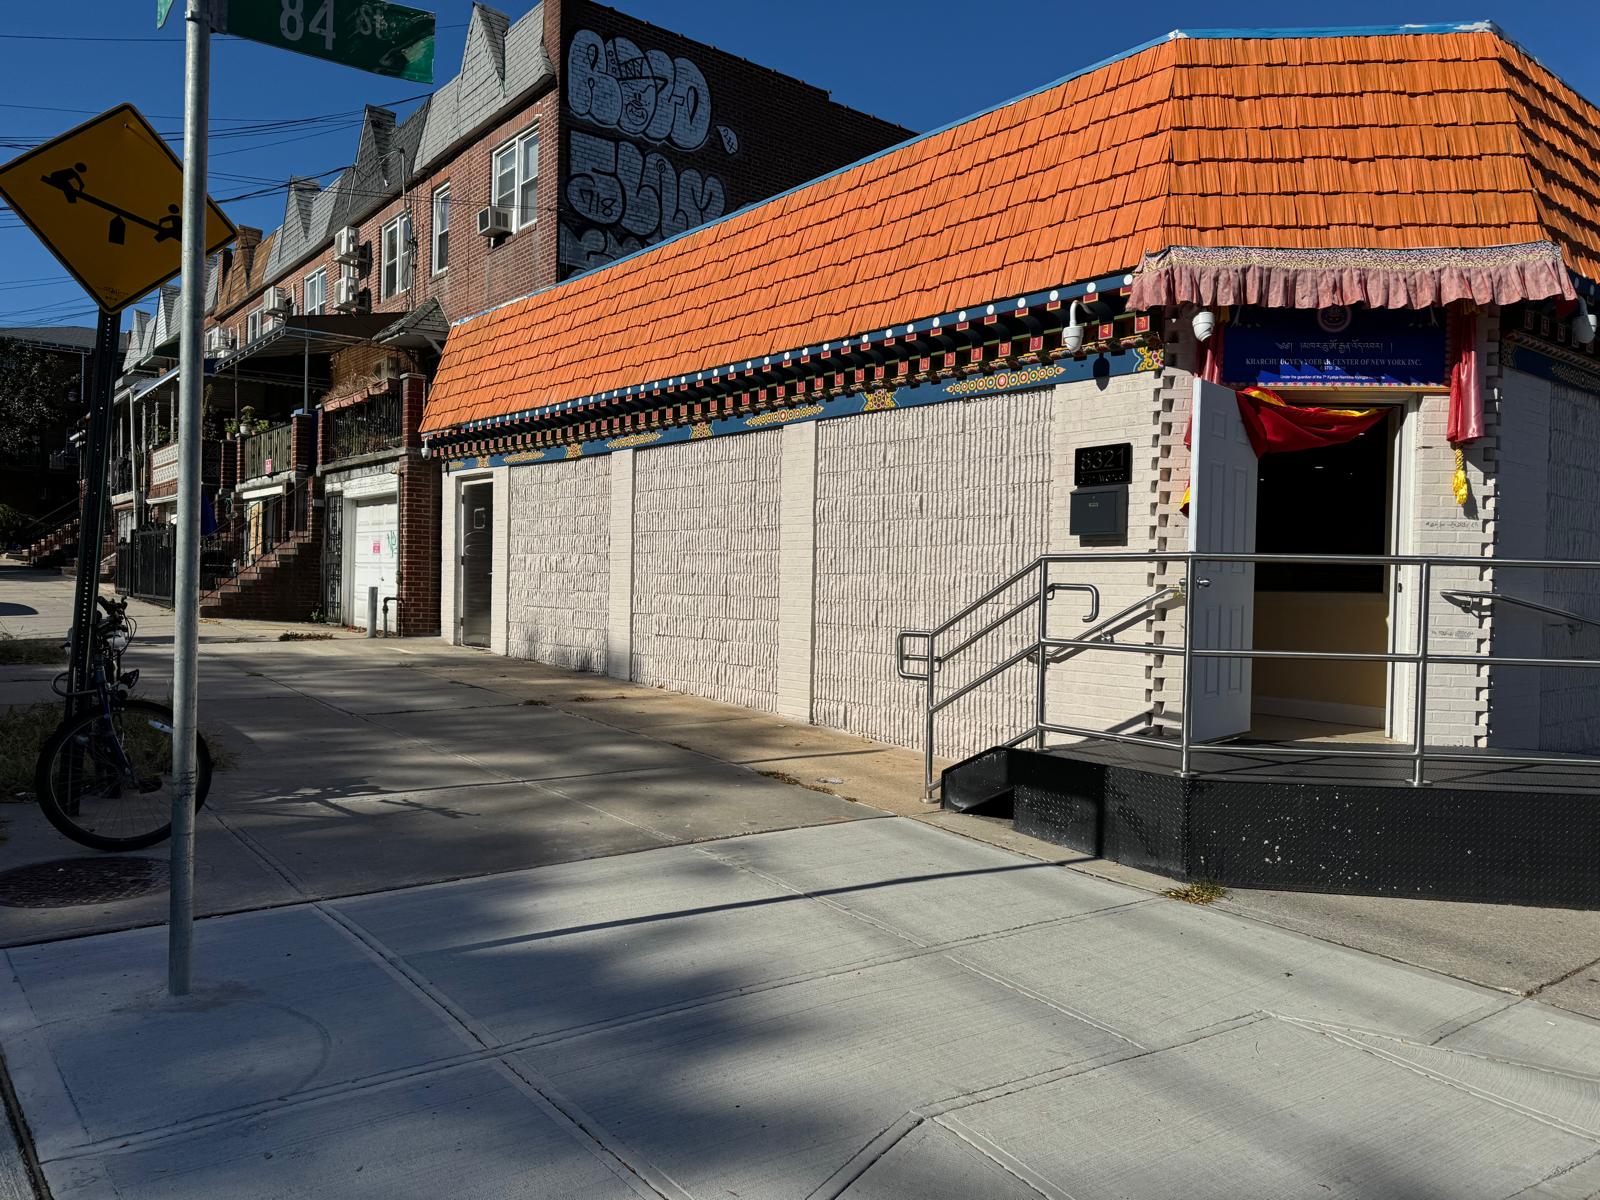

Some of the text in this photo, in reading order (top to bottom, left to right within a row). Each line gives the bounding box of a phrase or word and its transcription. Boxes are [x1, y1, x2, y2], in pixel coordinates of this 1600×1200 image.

[280, 0, 388, 50] 84 St
[1245, 358, 1279, 366] KHARCHU
[1279, 358, 1303, 366] UGYEN
[1332, 358, 1359, 366] CENTER
[1360, 358, 1370, 366] OF
[1371, 358, 1386, 366] NEW
[1387, 358, 1407, 366] YORK
[1080, 448, 1124, 470] 8321
